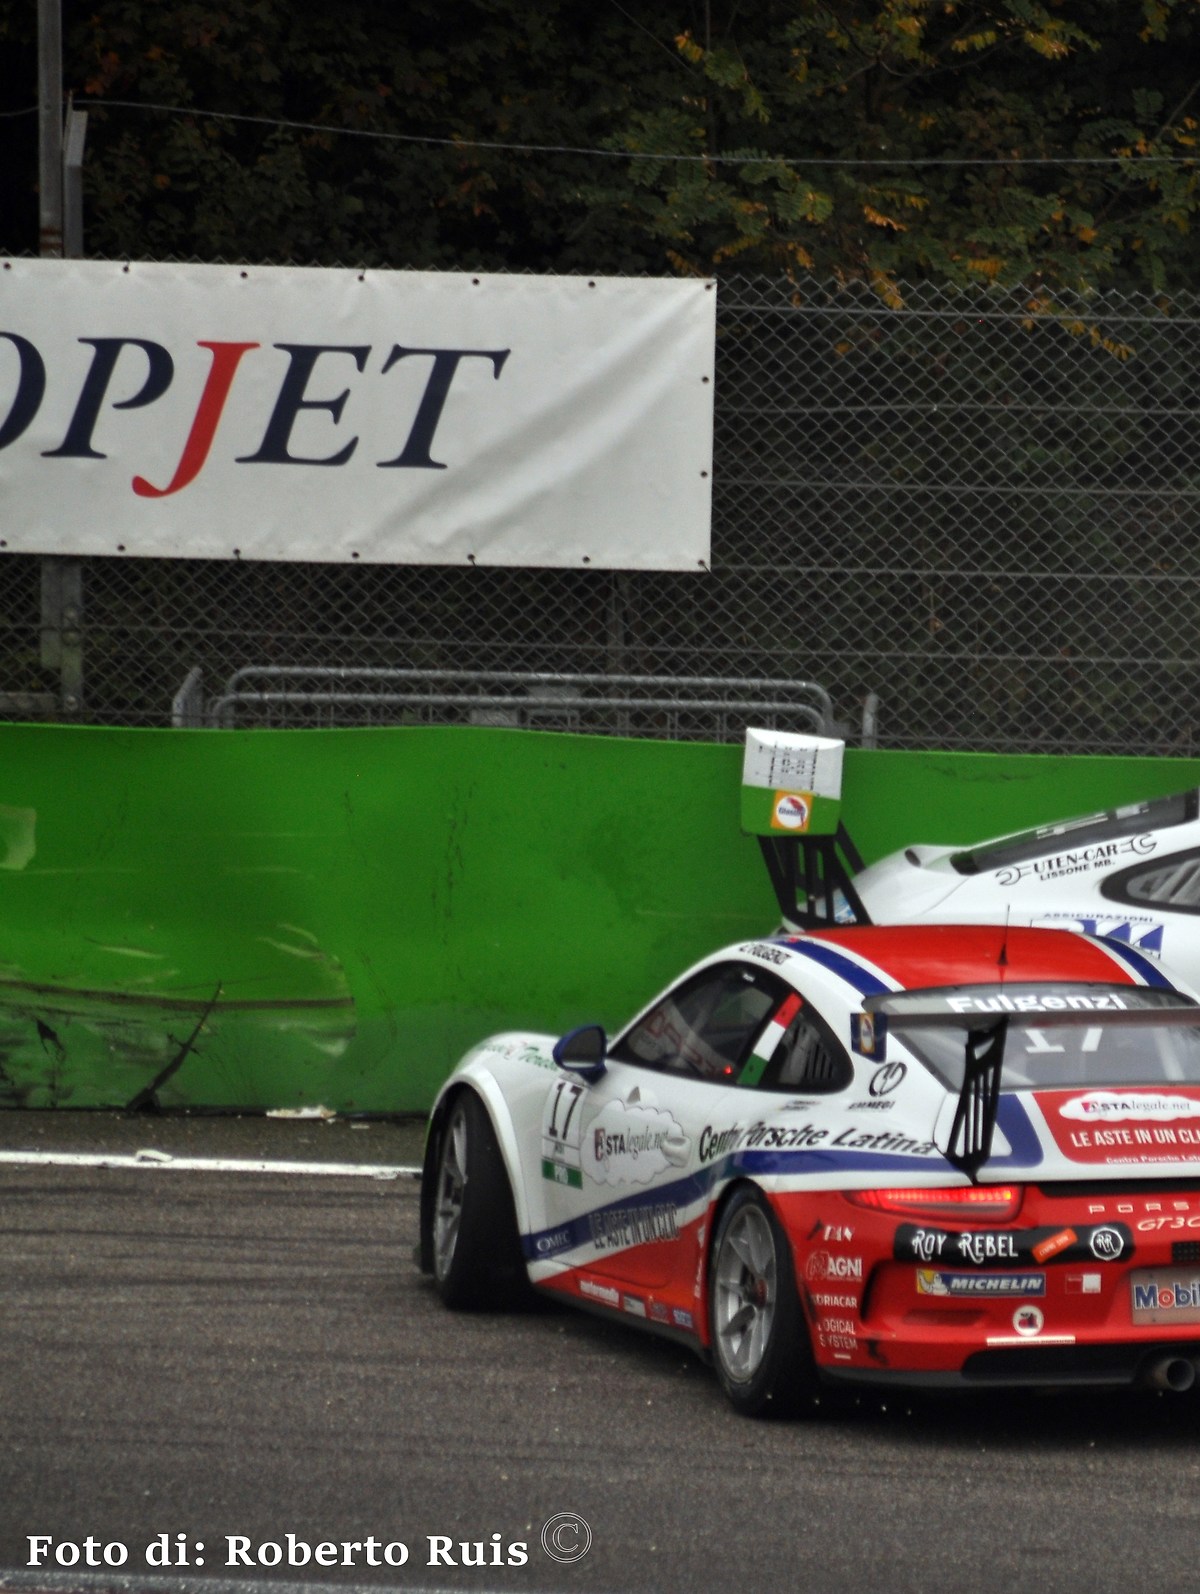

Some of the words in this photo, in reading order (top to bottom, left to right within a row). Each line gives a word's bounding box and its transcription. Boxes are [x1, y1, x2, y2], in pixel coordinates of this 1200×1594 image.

[1033, 842, 1118, 874] UTEN-CAR
[945, 993, 1128, 1013] Fulgenzi
[548, 1081, 584, 1141] 17
[831, 1127, 940, 1156] Latina
[1070, 1131, 1092, 1148] LE
[1095, 1129, 1131, 1146] ASTE
[1134, 1128, 1153, 1144] IN
[1154, 1129, 1177, 1145] UN
[911, 1229, 948, 1262] ROY
[957, 1231, 1019, 1264] REBEL
[950, 1276, 1043, 1290] MICHELIN
